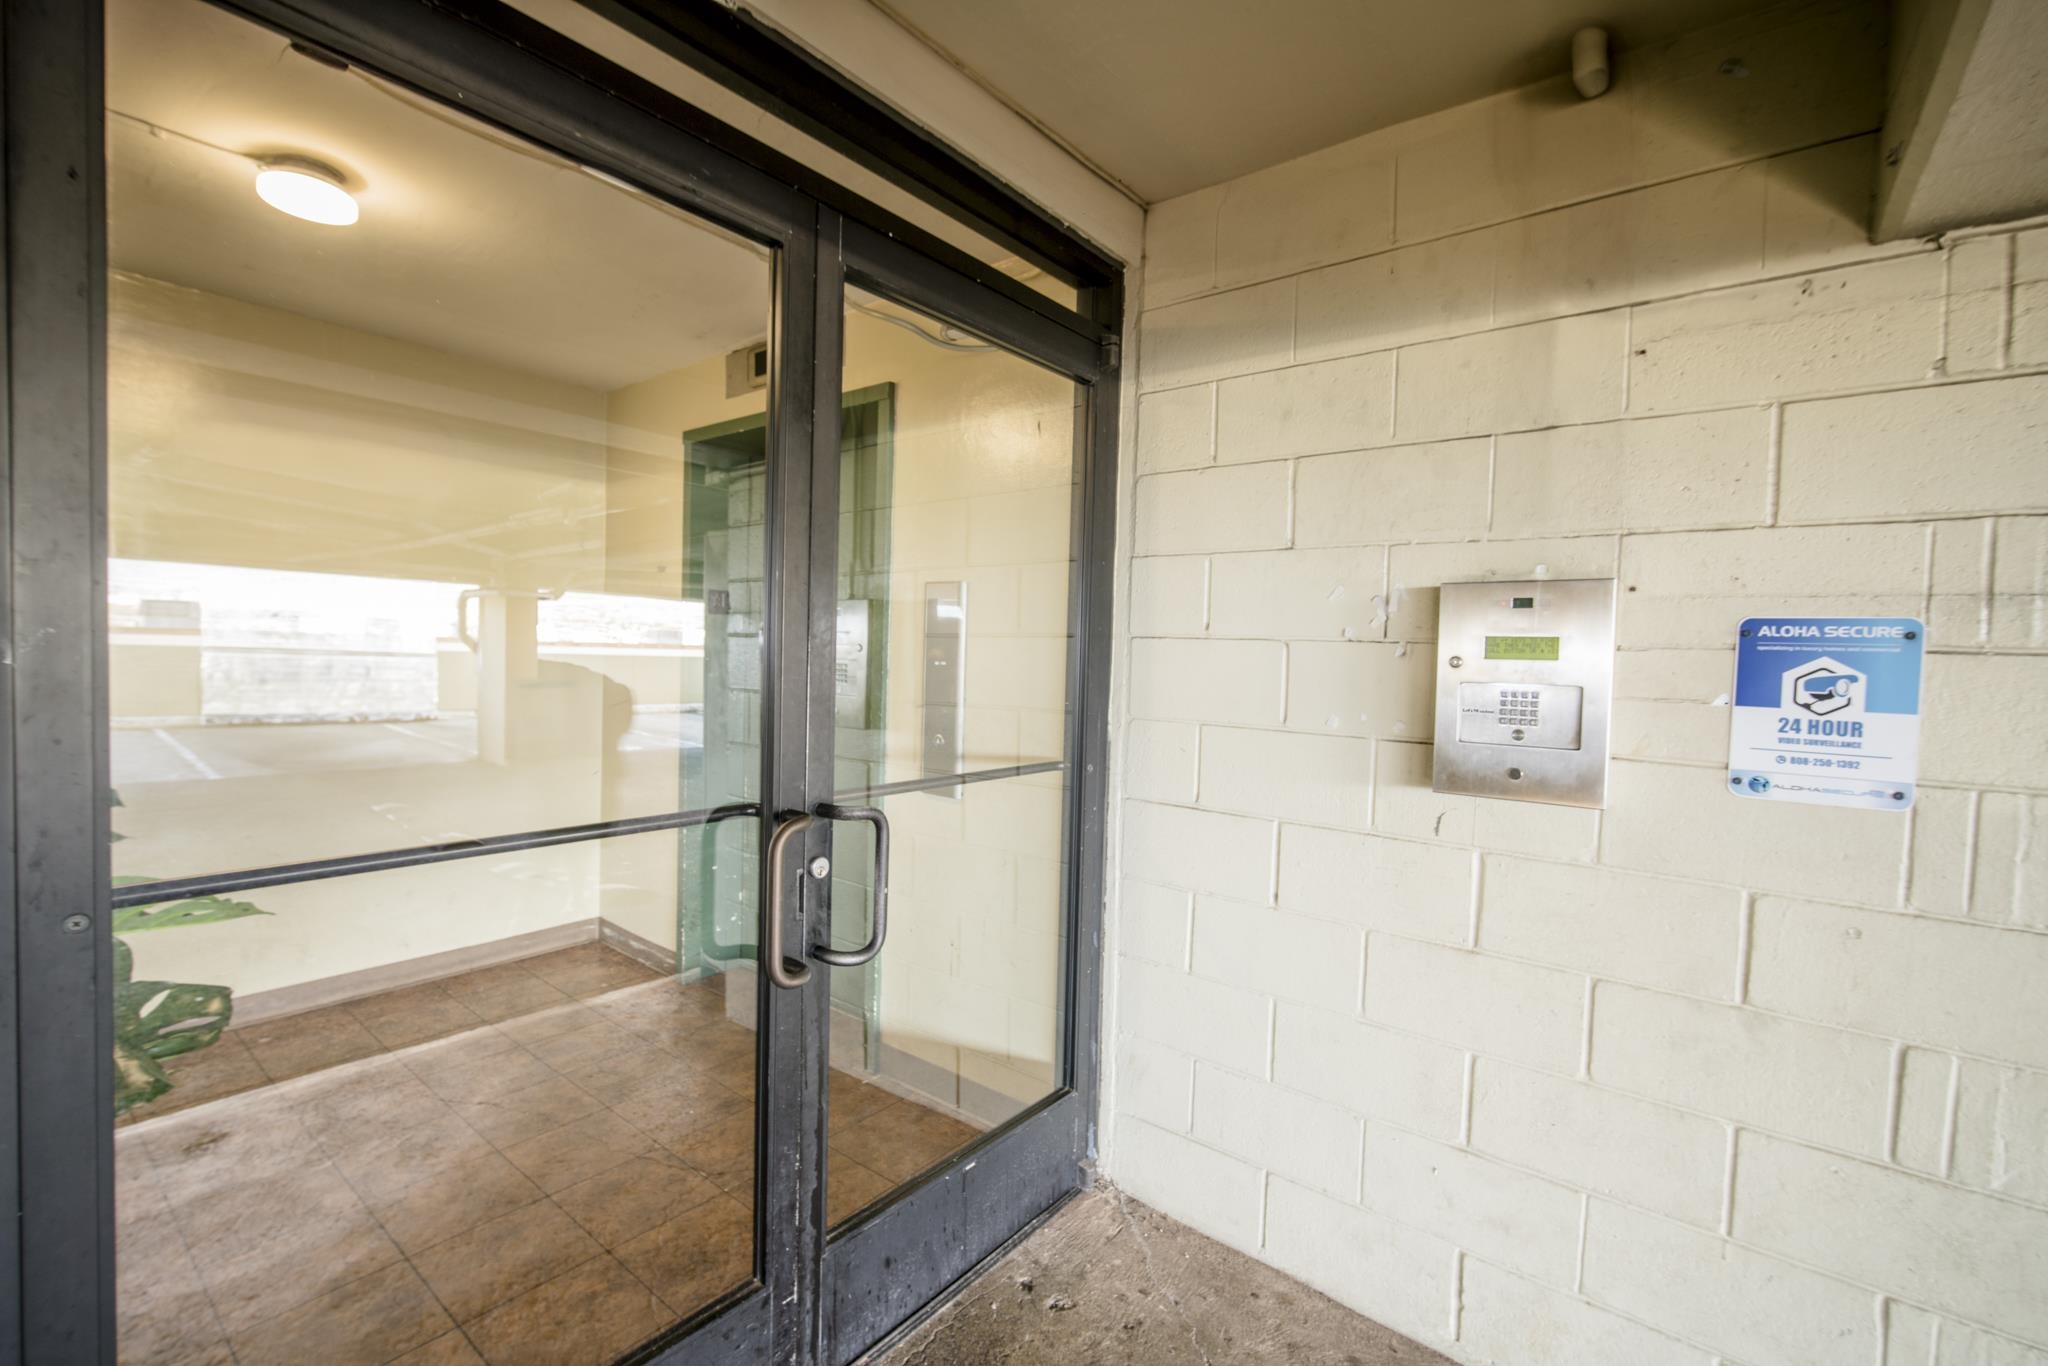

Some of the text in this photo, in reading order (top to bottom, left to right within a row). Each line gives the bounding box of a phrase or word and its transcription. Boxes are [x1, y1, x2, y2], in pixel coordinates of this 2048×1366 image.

[1757, 625, 1904, 639] ALOHA SECURE
[1777, 717, 1864, 738] 24 HOUR
[1777, 737, 1862, 749] VIDEO SURVEILLANCE
